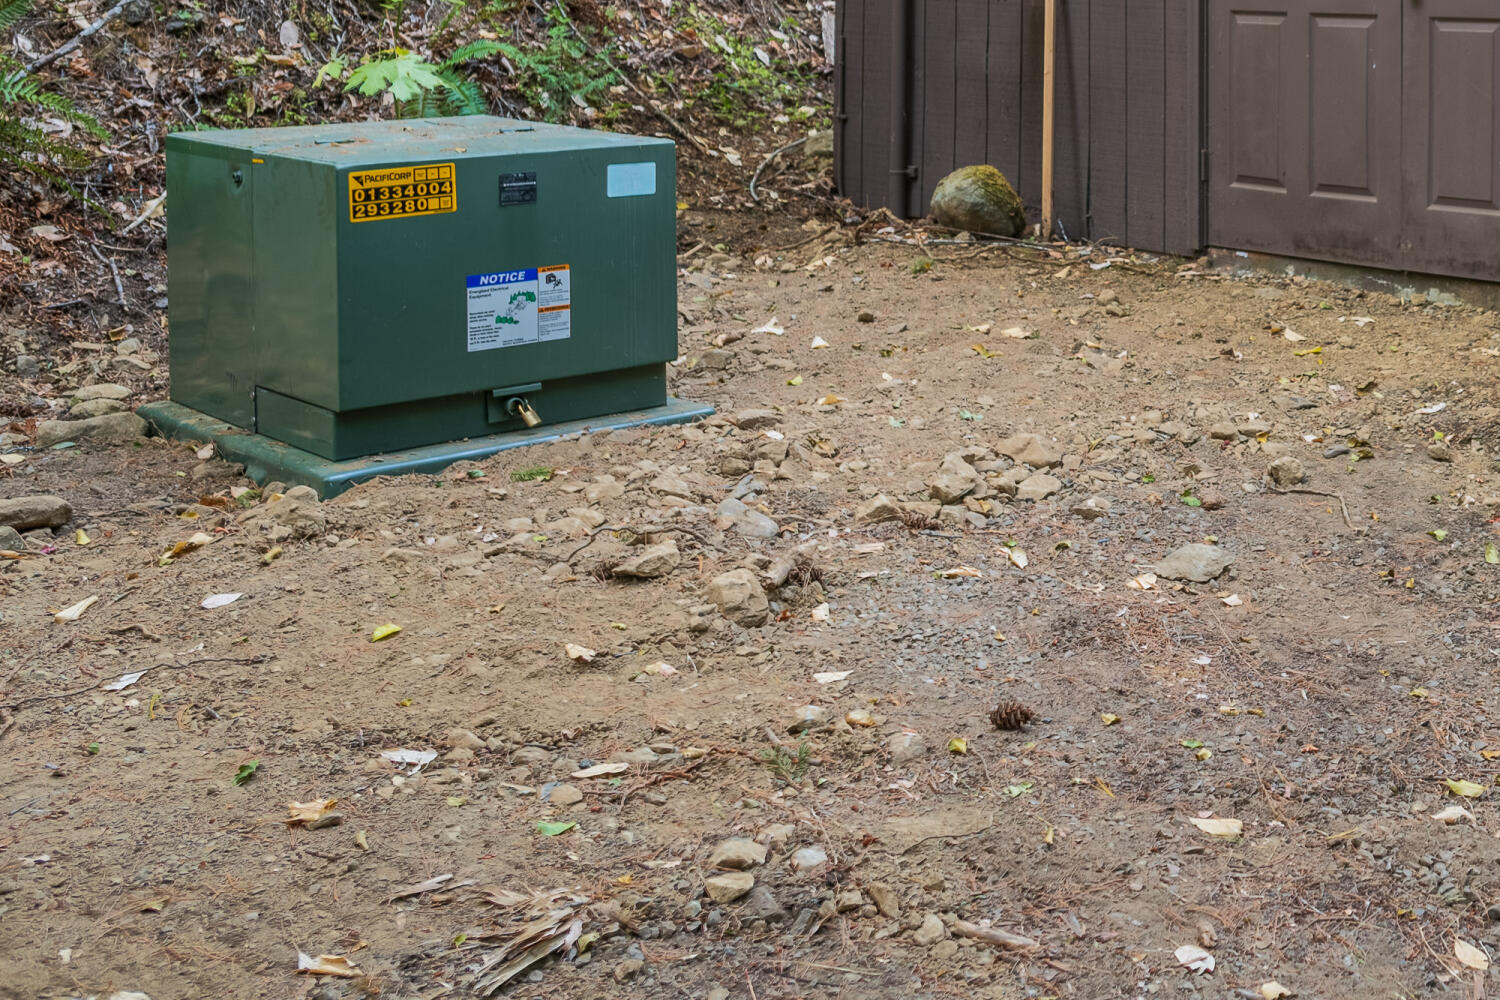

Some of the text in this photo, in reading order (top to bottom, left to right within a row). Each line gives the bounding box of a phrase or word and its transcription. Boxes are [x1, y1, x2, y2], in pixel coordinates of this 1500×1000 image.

[354, 181, 451, 201] 01334004
[355, 198, 428, 218] 293280
[480, 271, 525, 285] NOTICE
